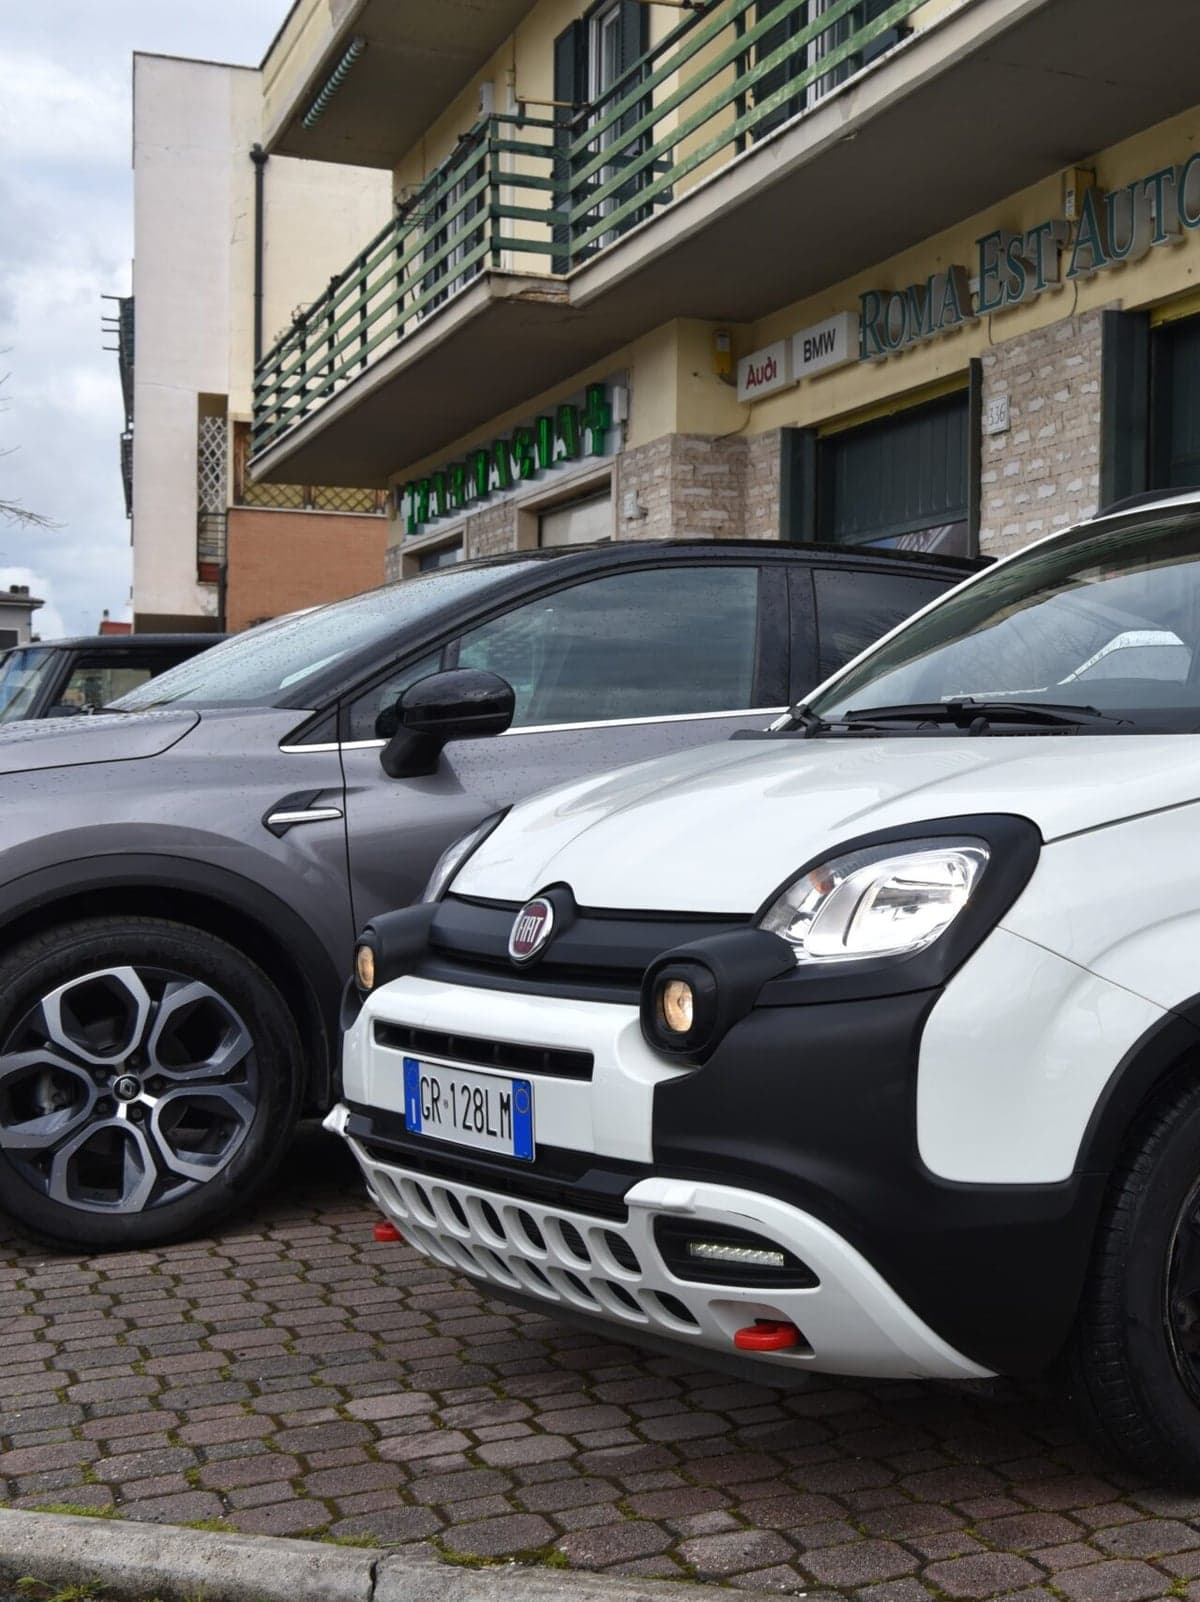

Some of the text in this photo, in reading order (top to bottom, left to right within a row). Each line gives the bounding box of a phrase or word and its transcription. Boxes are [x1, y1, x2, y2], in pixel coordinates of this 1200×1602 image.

[803, 327, 837, 363] BMW
[745, 356, 778, 391] Audi
[515, 916, 545, 943] FIAT
